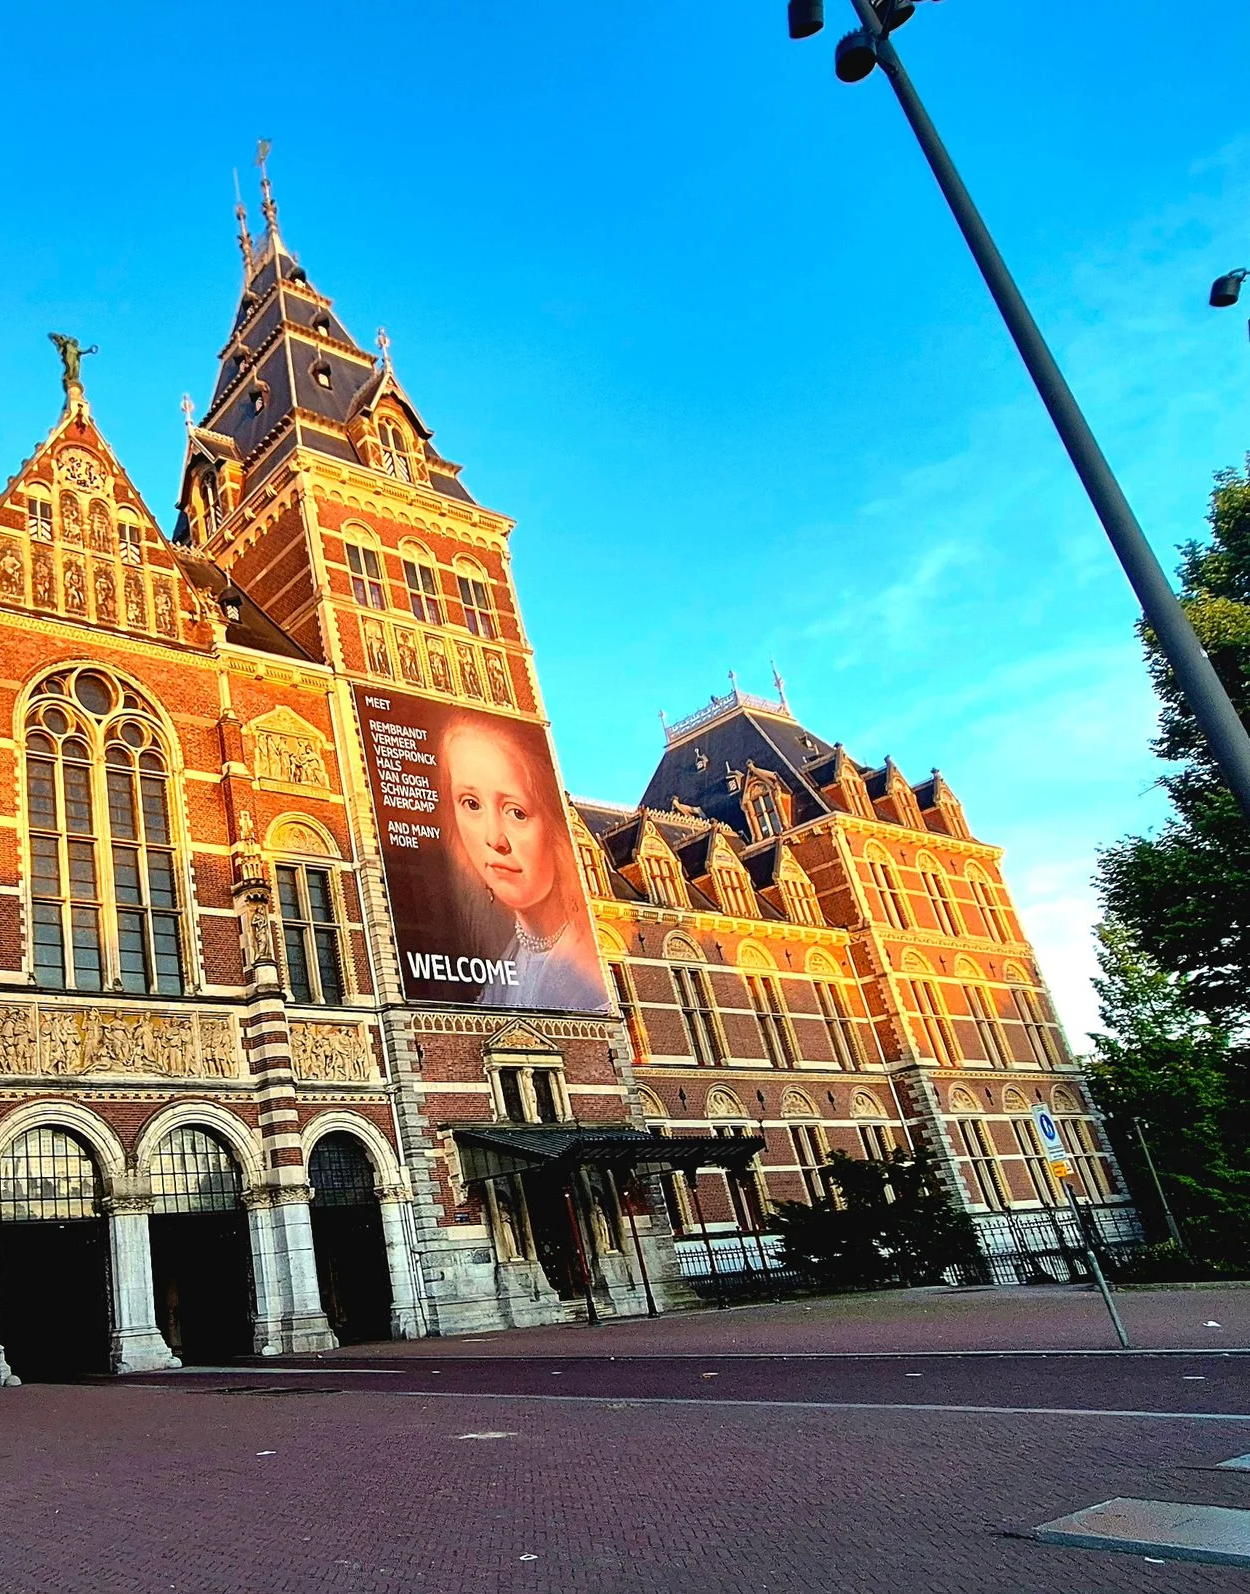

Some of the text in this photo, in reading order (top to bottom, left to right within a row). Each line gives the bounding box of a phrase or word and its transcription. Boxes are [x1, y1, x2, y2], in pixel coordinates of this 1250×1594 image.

[365, 696, 391, 710] MEET
[369, 720, 427, 740] REMBRANDT
[371, 732, 417, 750] VERMEER
[374, 744, 436, 765] VERSPRONCK
[376, 757, 402, 771] HALS
[378, 769, 429, 787] VAN GOGH
[381, 782, 438, 801] SCHWARTZE
[383, 795, 435, 812] AVERCAMP
[388, 821, 440, 839] AND MANY
[390, 834, 418, 848] MORE
[406, 952, 519, 986] WELCOME
